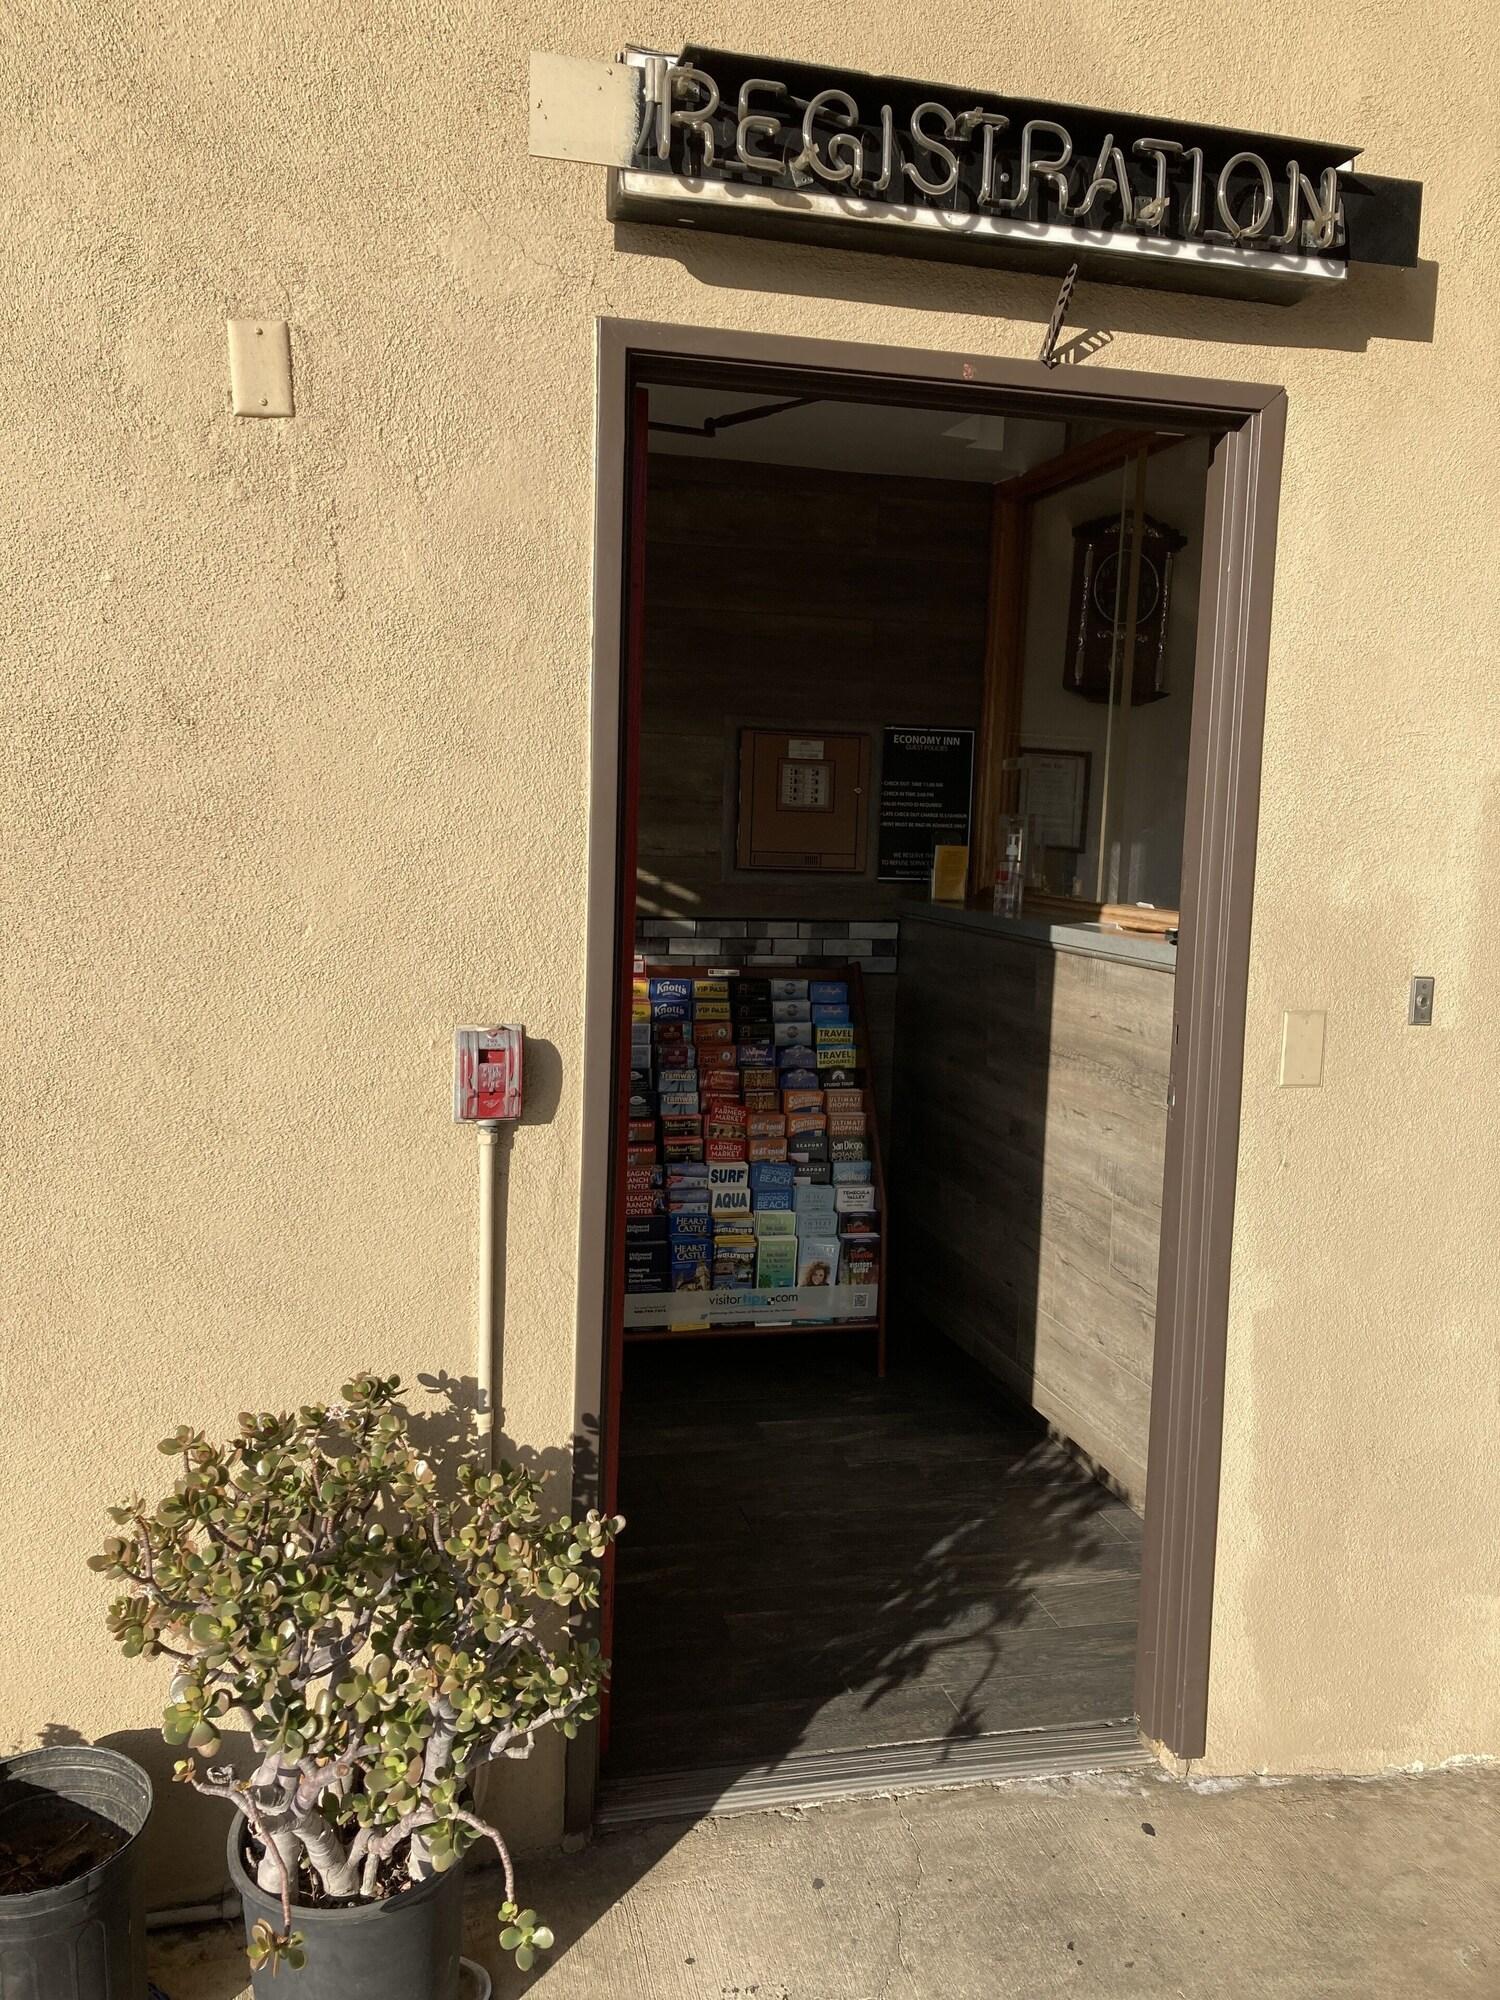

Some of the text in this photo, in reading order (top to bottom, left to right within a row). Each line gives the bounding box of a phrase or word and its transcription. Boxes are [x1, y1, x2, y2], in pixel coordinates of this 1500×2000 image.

[660, 66, 1346, 248] REGISTRATION
[893, 734, 960, 746] ECONOMY INN
[819, 1029, 852, 1038] TRAVEL
[818, 1050, 852, 1060] TRAVEL
[660, 1071, 697, 1080] Tramway
[714, 1107, 746, 1117] FARMERS
[714, 1113, 744, 1123] MARKET
[710, 1144, 743, 1152] FARMERS
[832, 1140, 863, 1151] San Diego
[710, 1169, 745, 1183] SURF
[761, 1168, 792, 1177] REDONDO
[759, 1174, 791, 1184] BEACH
[714, 1192, 747, 1209] AQUA
[757, 1200, 789, 1209] BEACH
[676, 1216, 708, 1226] HEARST
[678, 1224, 707, 1233] CASTLE
[674, 1243, 707, 1253] HEARST
[677, 1251, 707, 1261] CASTLE
